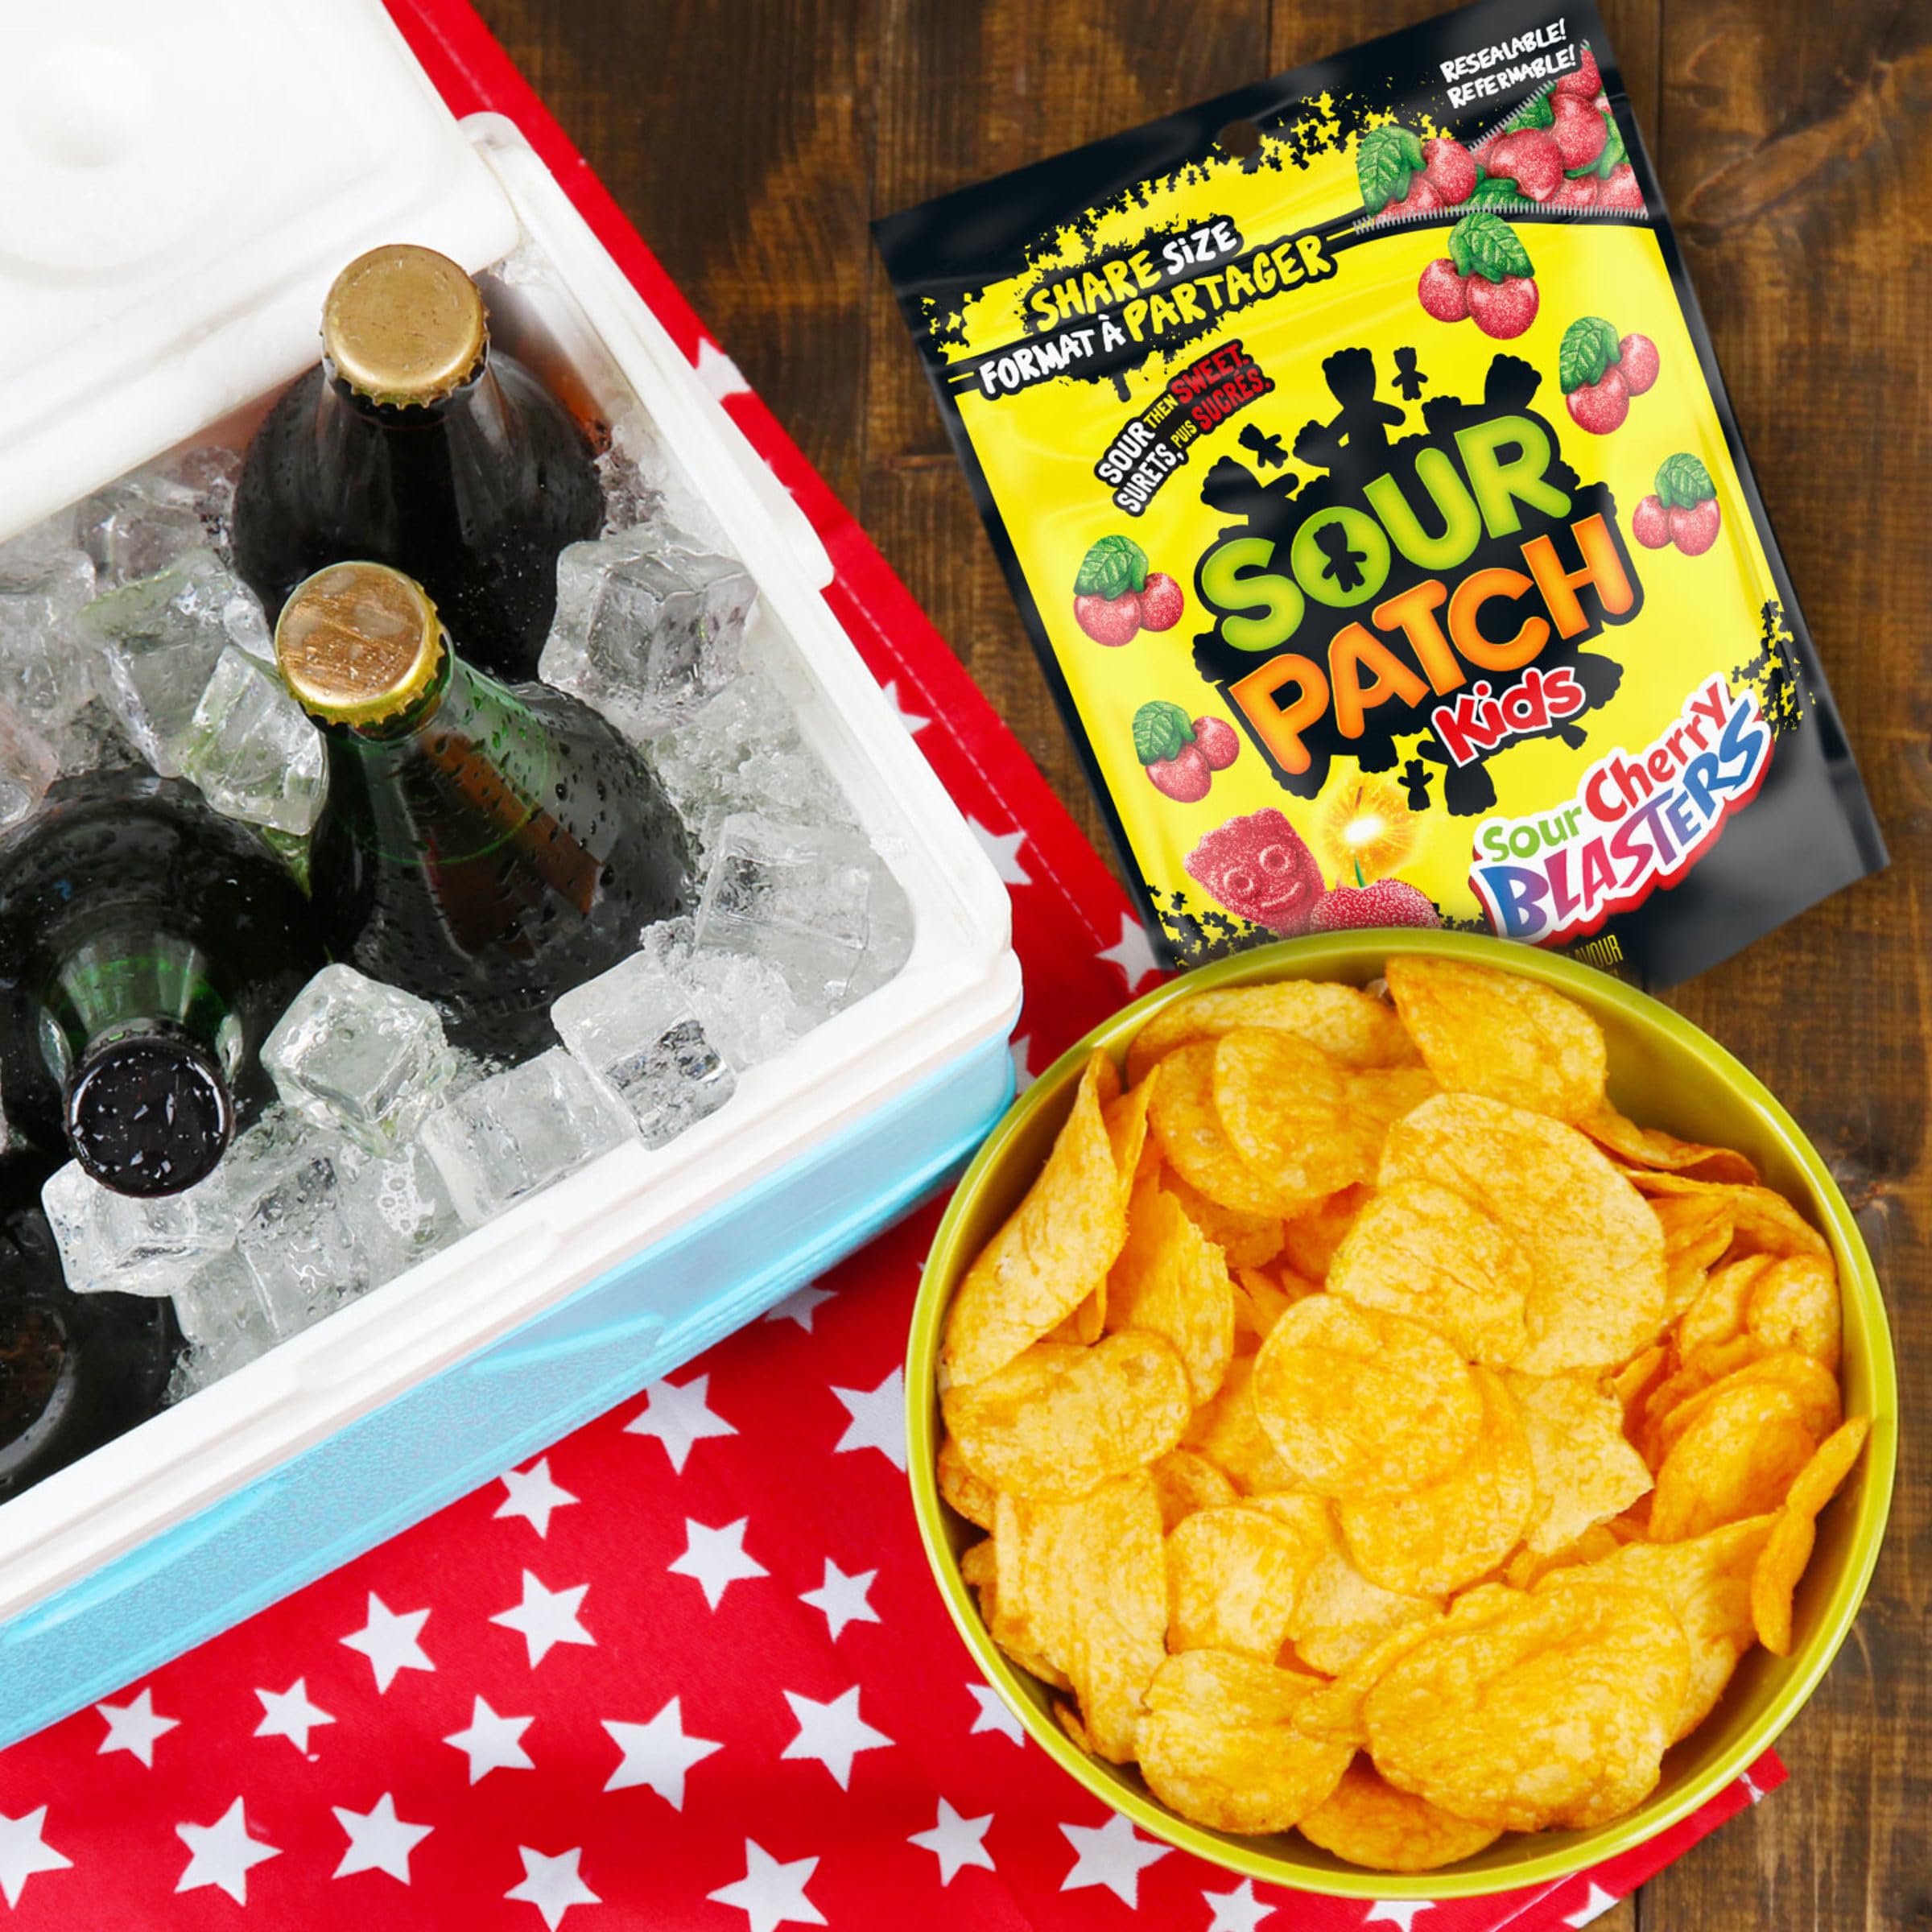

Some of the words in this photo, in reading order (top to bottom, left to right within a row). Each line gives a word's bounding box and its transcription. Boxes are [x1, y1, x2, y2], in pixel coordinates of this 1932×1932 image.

[1439, 18, 1567, 83] RESEALABLE!
[1447, 44, 1576, 109] REFERMABLE!
[978, 328, 1095, 395] FORMAT
[1097, 314, 1126, 353] À
[1123, 234, 1332, 342] PARTAGER
[1029, 250, 1162, 332] SHARE
[1098, 421, 1156, 485] SOUR
[1143, 394, 1179, 431] THEN
[1171, 344, 1250, 404] SWEET.
[1117, 442, 1185, 514] SURETS,
[1170, 419, 1198, 449] PUIS
[1191, 367, 1273, 430] SUCRÉS.
[1201, 415, 1572, 652] SOUR
[1228, 512, 1634, 775] PATCH
[1433, 667, 1585, 766] Kids
[1479, 698, 1765, 939] BLASTERS
[1482, 806, 1583, 862] Sour
[1585, 681, 1728, 823] Cherry
